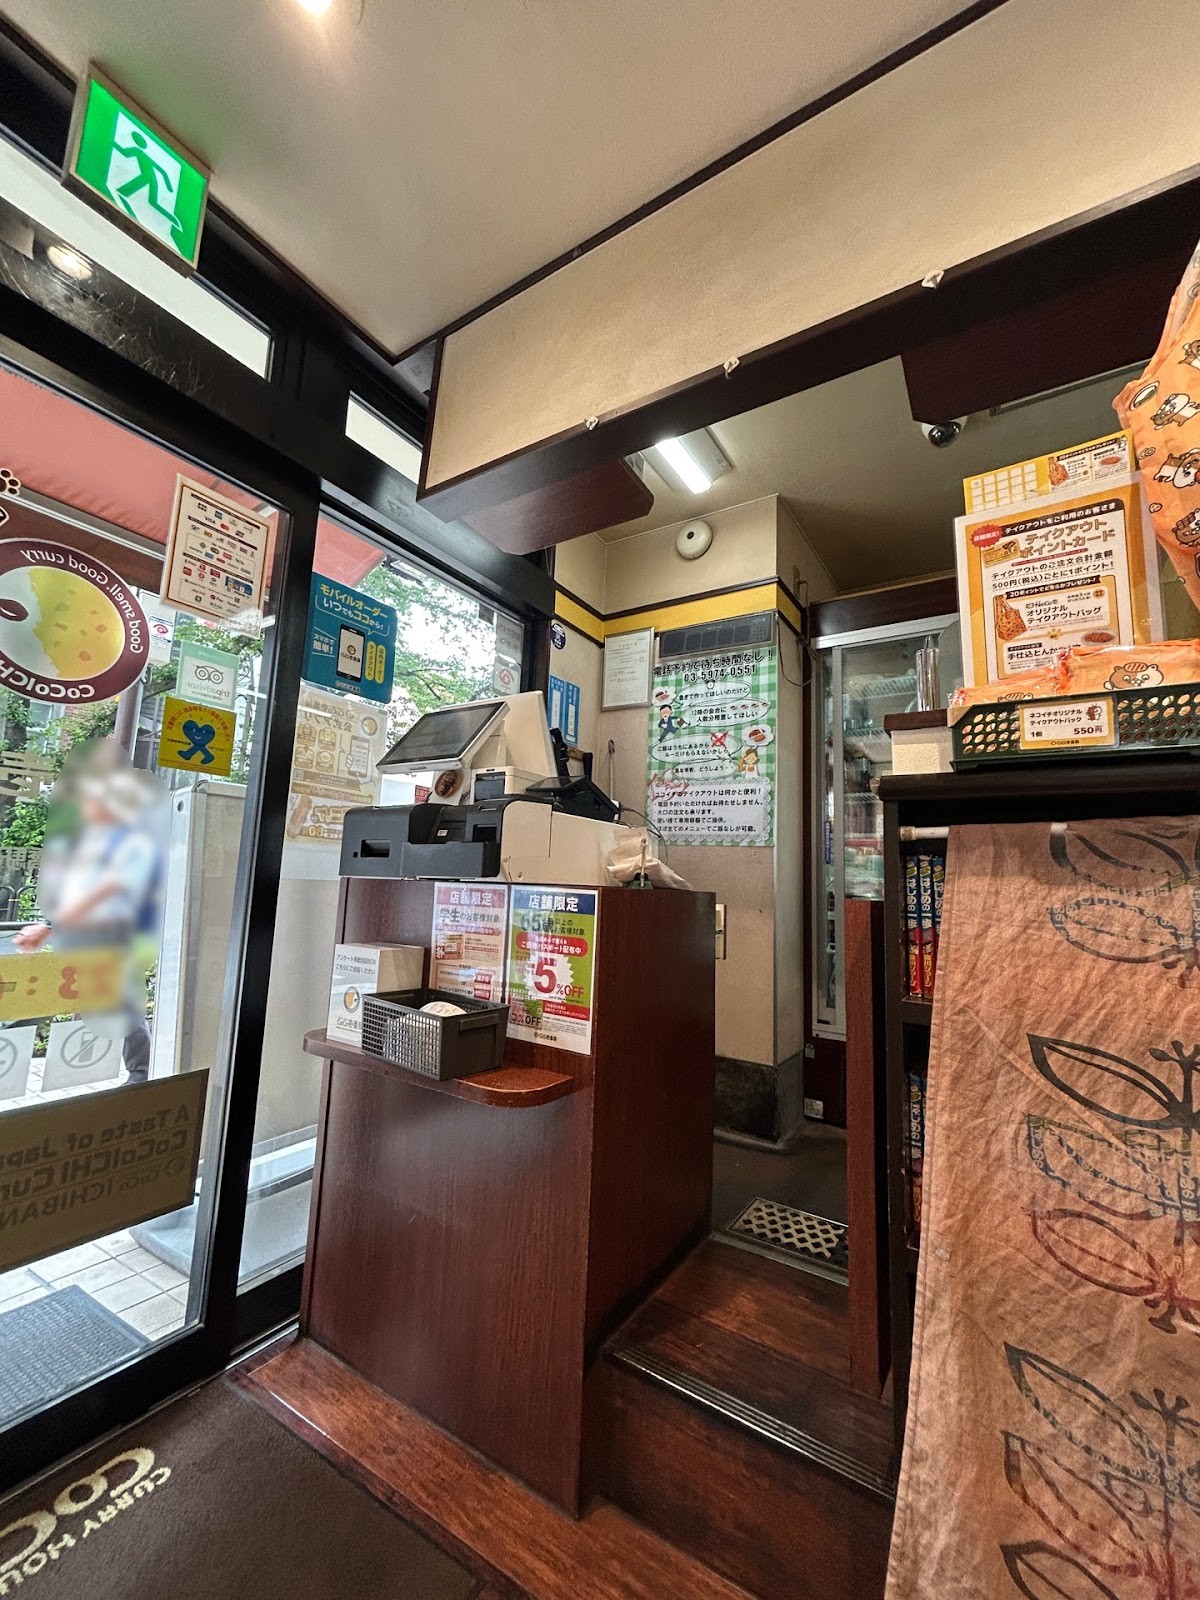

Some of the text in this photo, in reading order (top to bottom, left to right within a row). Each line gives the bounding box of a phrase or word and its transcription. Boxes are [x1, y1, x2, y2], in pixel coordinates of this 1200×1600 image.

[1004, 502, 1116, 535] テイクアウトをご利用のお客さま
[1025, 518, 1107, 545] テイクアウト
[1019, 528, 1116, 560] ポイントカード
[991, 549, 1114, 580] テイクアウトのご注文合計金額
[320, 583, 388, 618] モバイルオーダー
[1026, 604, 1068, 617] オリジナル
[323, 597, 384, 631] いつでもココから!
[1027, 606, 1101, 624] テイクアウトバッグ
[1008, 647, 1061, 662] 手仕込とんか
[684, 664, 756, 683] 03-5974-0551
[1029, 709, 1083, 718] ネコイチオリジナル
[1073, 725, 1104, 736] 550円
[450, 890, 492, 908] 店舗限定
[528, 894, 579, 912] 店舗限定
[907, 878, 918, 930] はじめの一歩
[921, 877, 932, 930] はじめの一歩
[439, 908, 500, 925] 学生のお客様対象
[82, 1465, 172, 1539] CURRY
